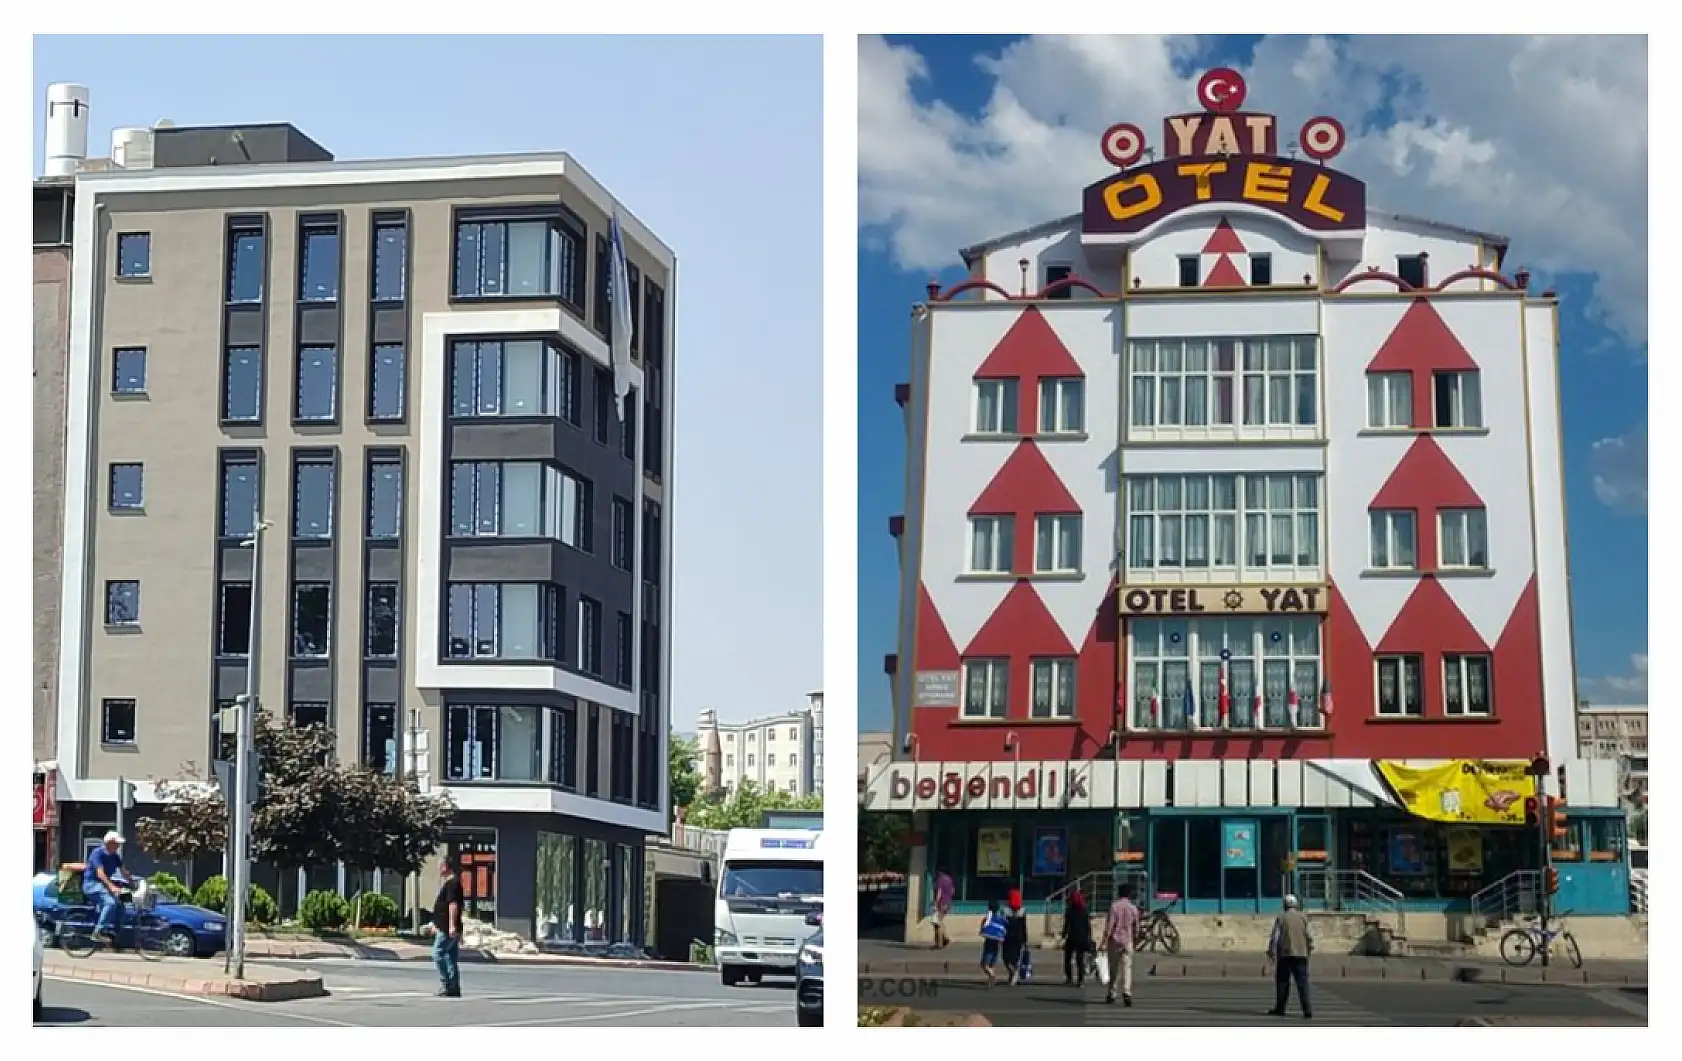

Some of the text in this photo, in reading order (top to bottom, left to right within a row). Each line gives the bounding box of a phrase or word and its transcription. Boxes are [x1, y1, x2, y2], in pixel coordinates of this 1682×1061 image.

[1169, 115, 1273, 156] YAT
[1103, 161, 1346, 223] OTEL
[1125, 588, 1320, 612] OTEL YAT
